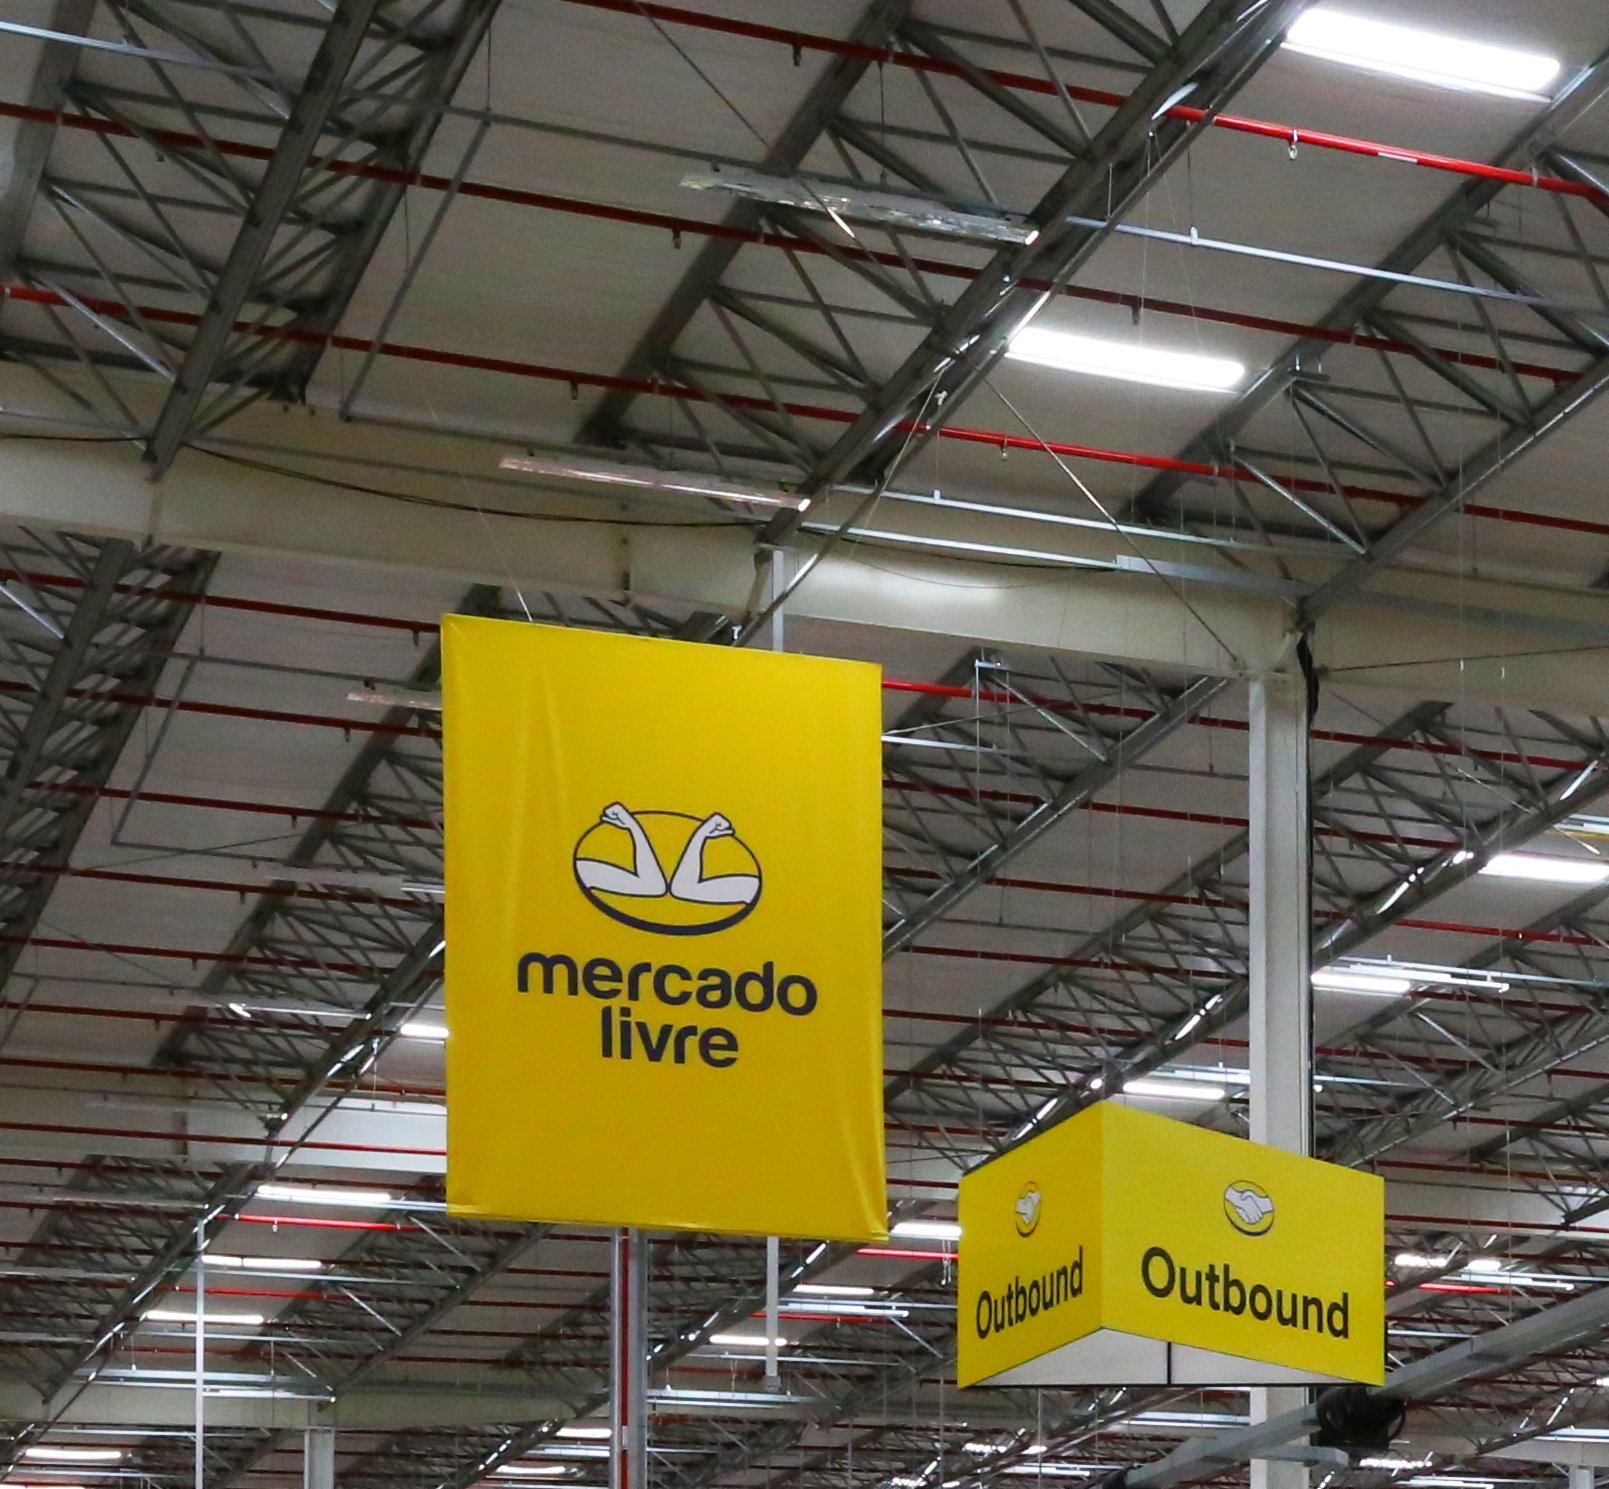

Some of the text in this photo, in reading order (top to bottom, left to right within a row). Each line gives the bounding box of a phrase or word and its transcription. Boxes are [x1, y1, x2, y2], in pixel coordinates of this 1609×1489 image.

[517, 951, 818, 1017] mercado
[601, 1005, 739, 1069] livre
[976, 1245, 1083, 1340] Outbound
[1141, 1246, 1349, 1339] Outbound
